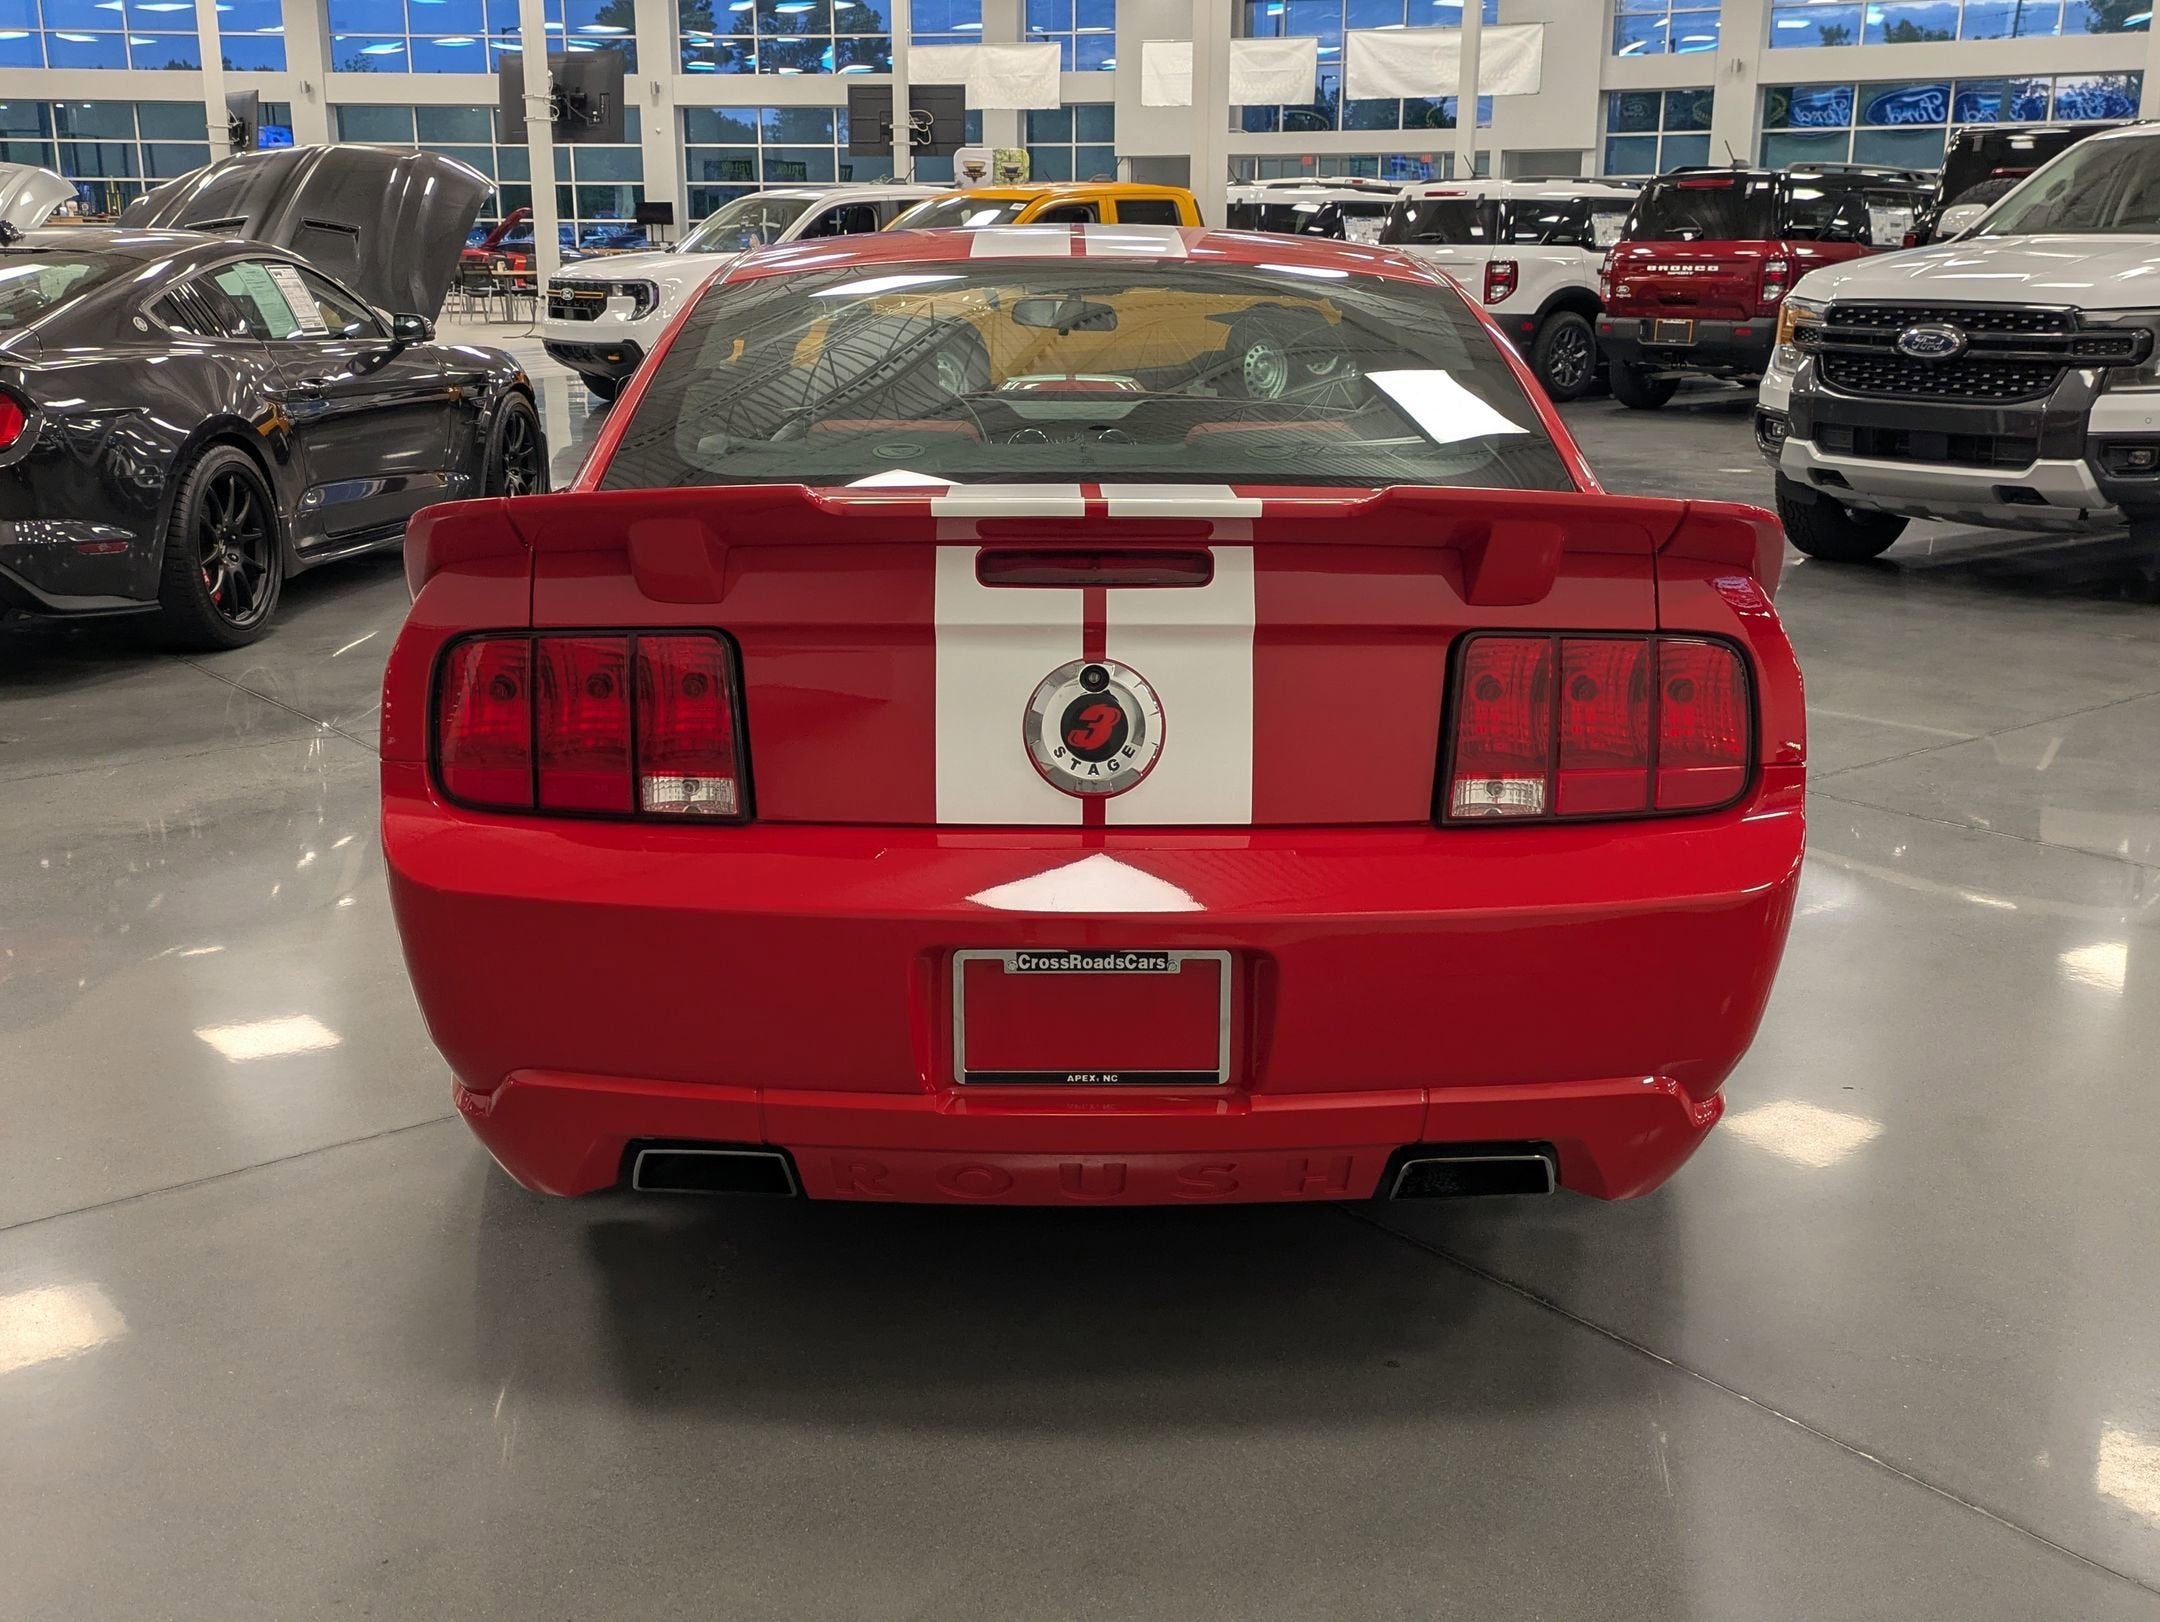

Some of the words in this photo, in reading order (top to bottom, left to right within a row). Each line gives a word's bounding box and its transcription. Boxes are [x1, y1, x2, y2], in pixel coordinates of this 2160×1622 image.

[1912, 334, 1945, 351] Ford
[1067, 703, 1121, 750] 3
[1053, 745, 1136, 776] STAGE
[1018, 954, 1166, 970] CrossRoadsCars
[1102, 1074, 1118, 1082] NC
[830, 1155, 1353, 1199] ROUSH
